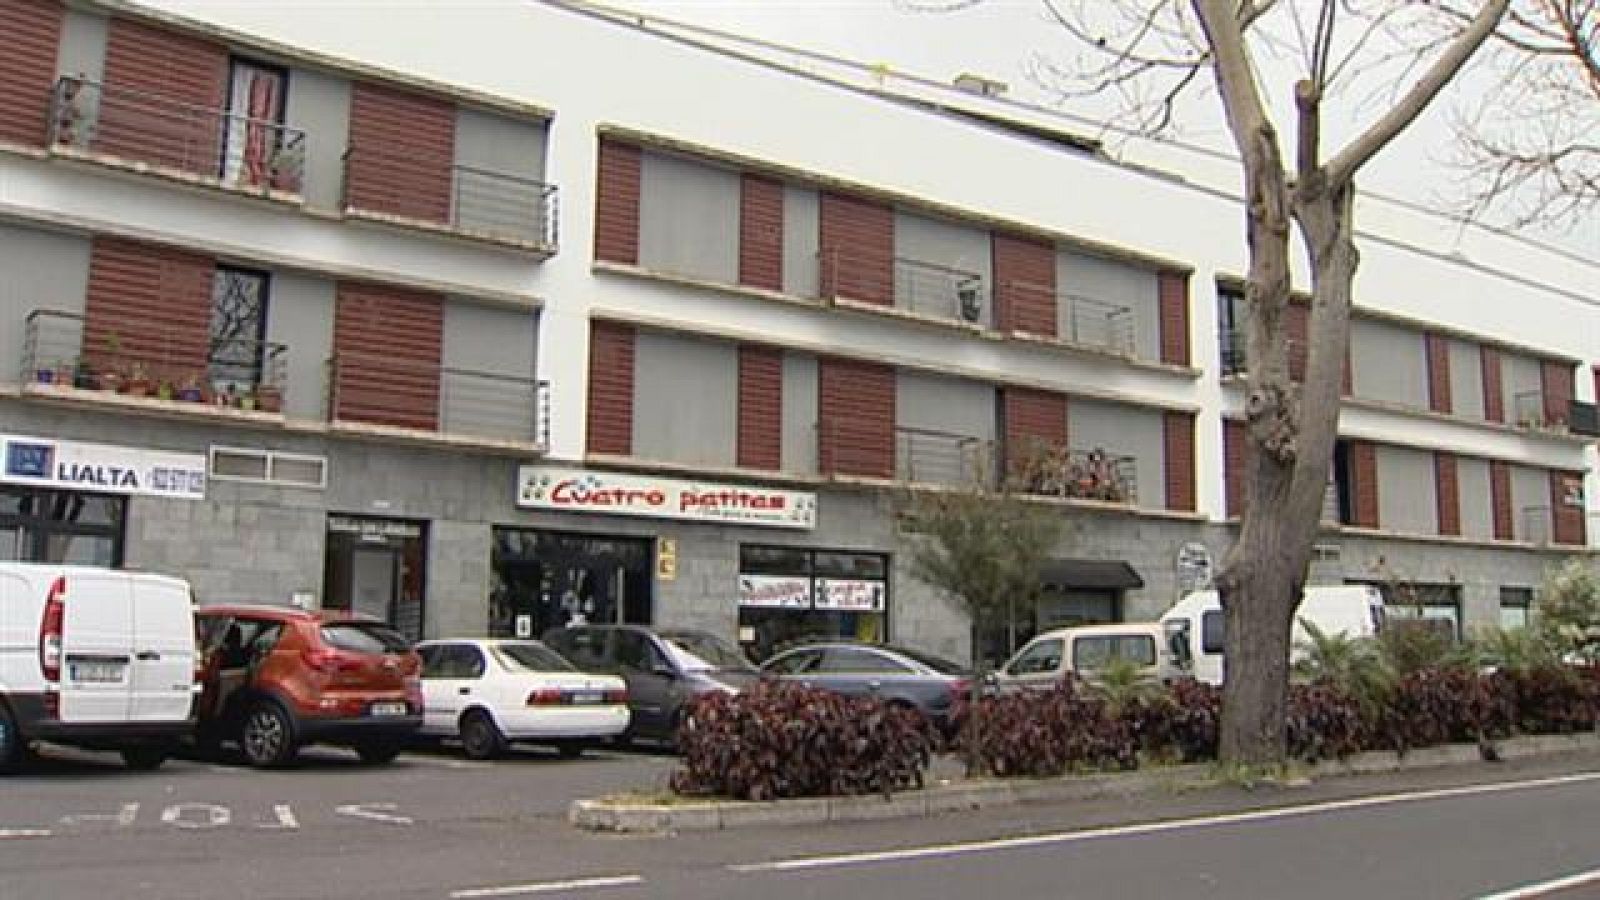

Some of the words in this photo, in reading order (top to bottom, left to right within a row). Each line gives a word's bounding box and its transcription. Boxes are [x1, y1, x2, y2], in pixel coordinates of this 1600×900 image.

[58, 462, 138, 488] LIALTA
[550, 480, 665, 506] Cuatro
[680, 490, 786, 513] patitas
